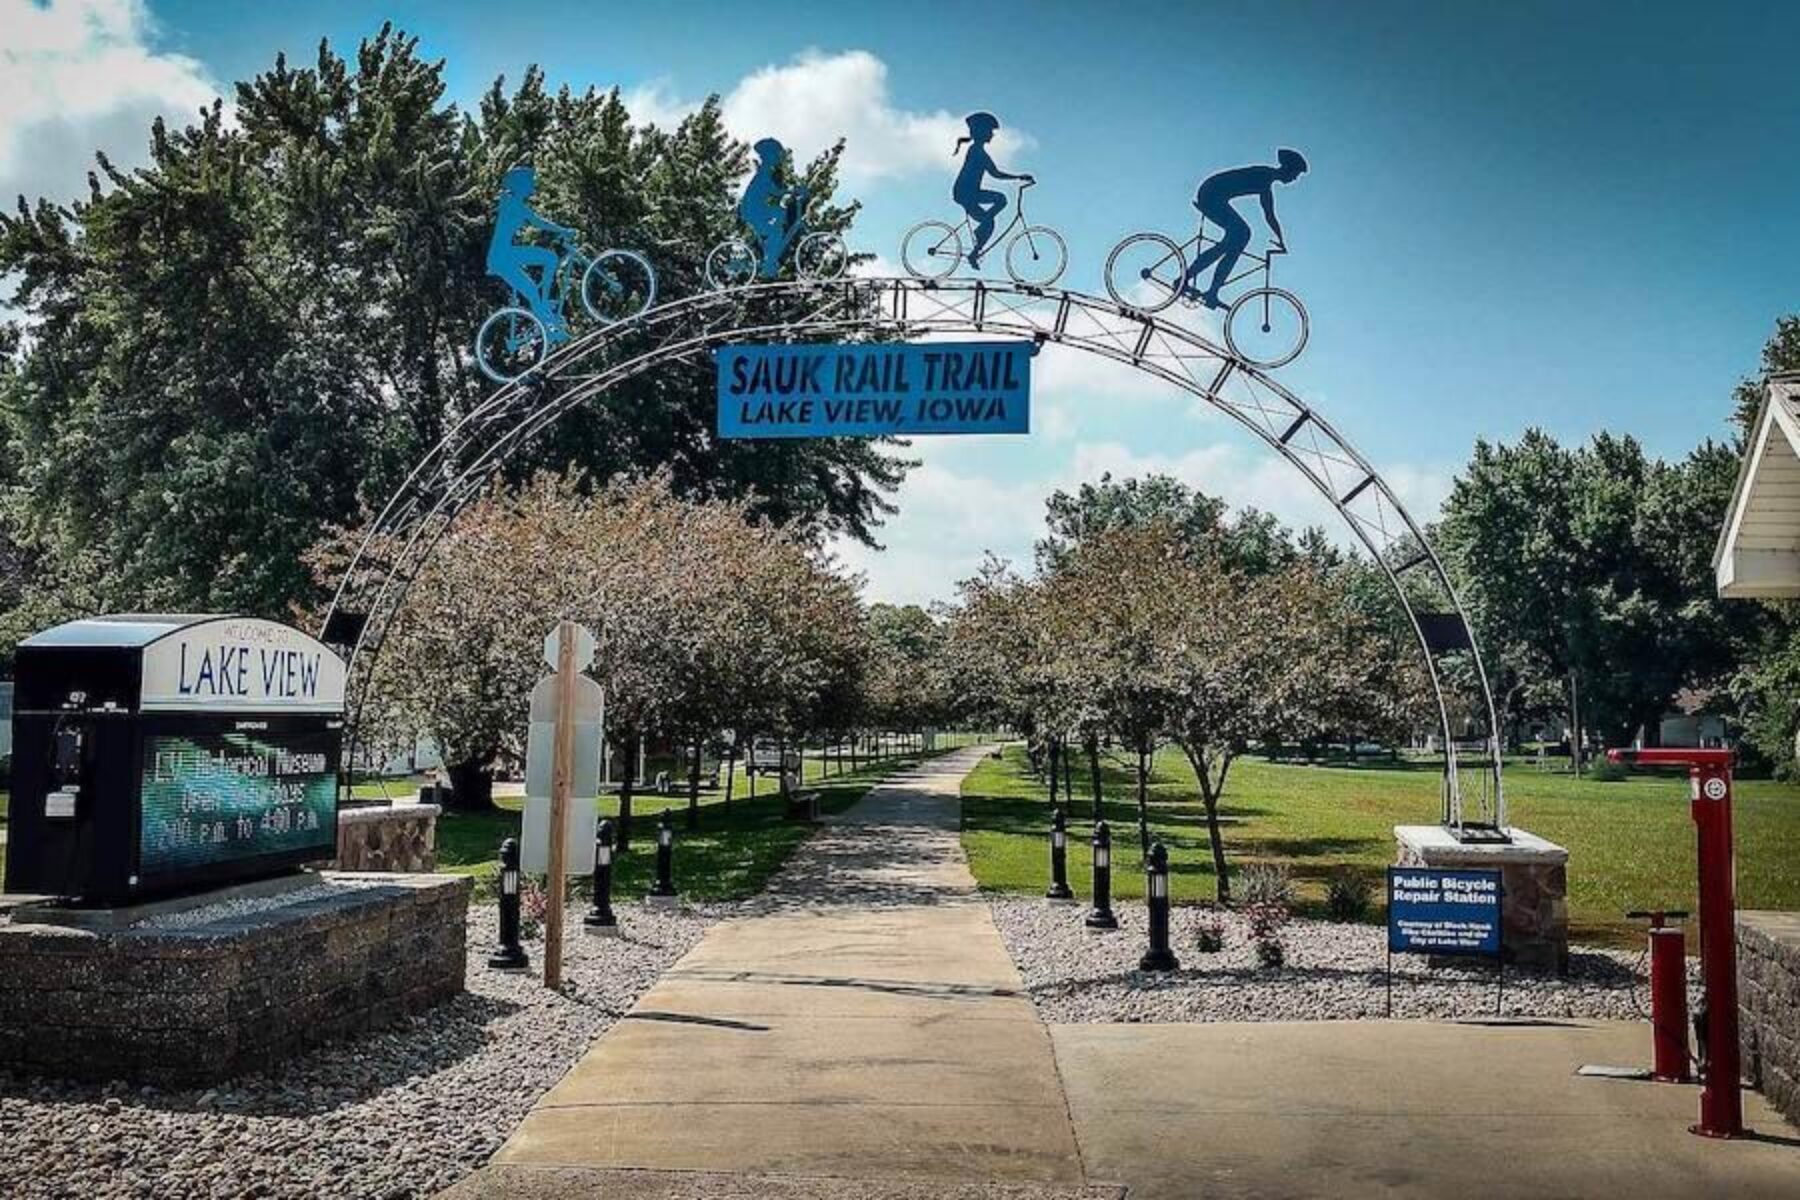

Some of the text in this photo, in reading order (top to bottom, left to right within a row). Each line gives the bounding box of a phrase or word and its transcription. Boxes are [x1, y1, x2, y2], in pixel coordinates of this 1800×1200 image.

[730, 351, 1019, 395] SAUK RAIL TRAIL
[740, 398, 1006, 425] LAKE VIEW, IOWA
[224, 623, 289, 644] WELCOME TO
[179, 642, 321, 698] LAKE VIEW
[275, 747, 326, 775] Museum
[236, 811, 253, 839] to
[1393, 875, 1496, 893] Public Bicycle
[1393, 889, 1497, 904] Repair Station
[1434, 921, 1443, 929] of
